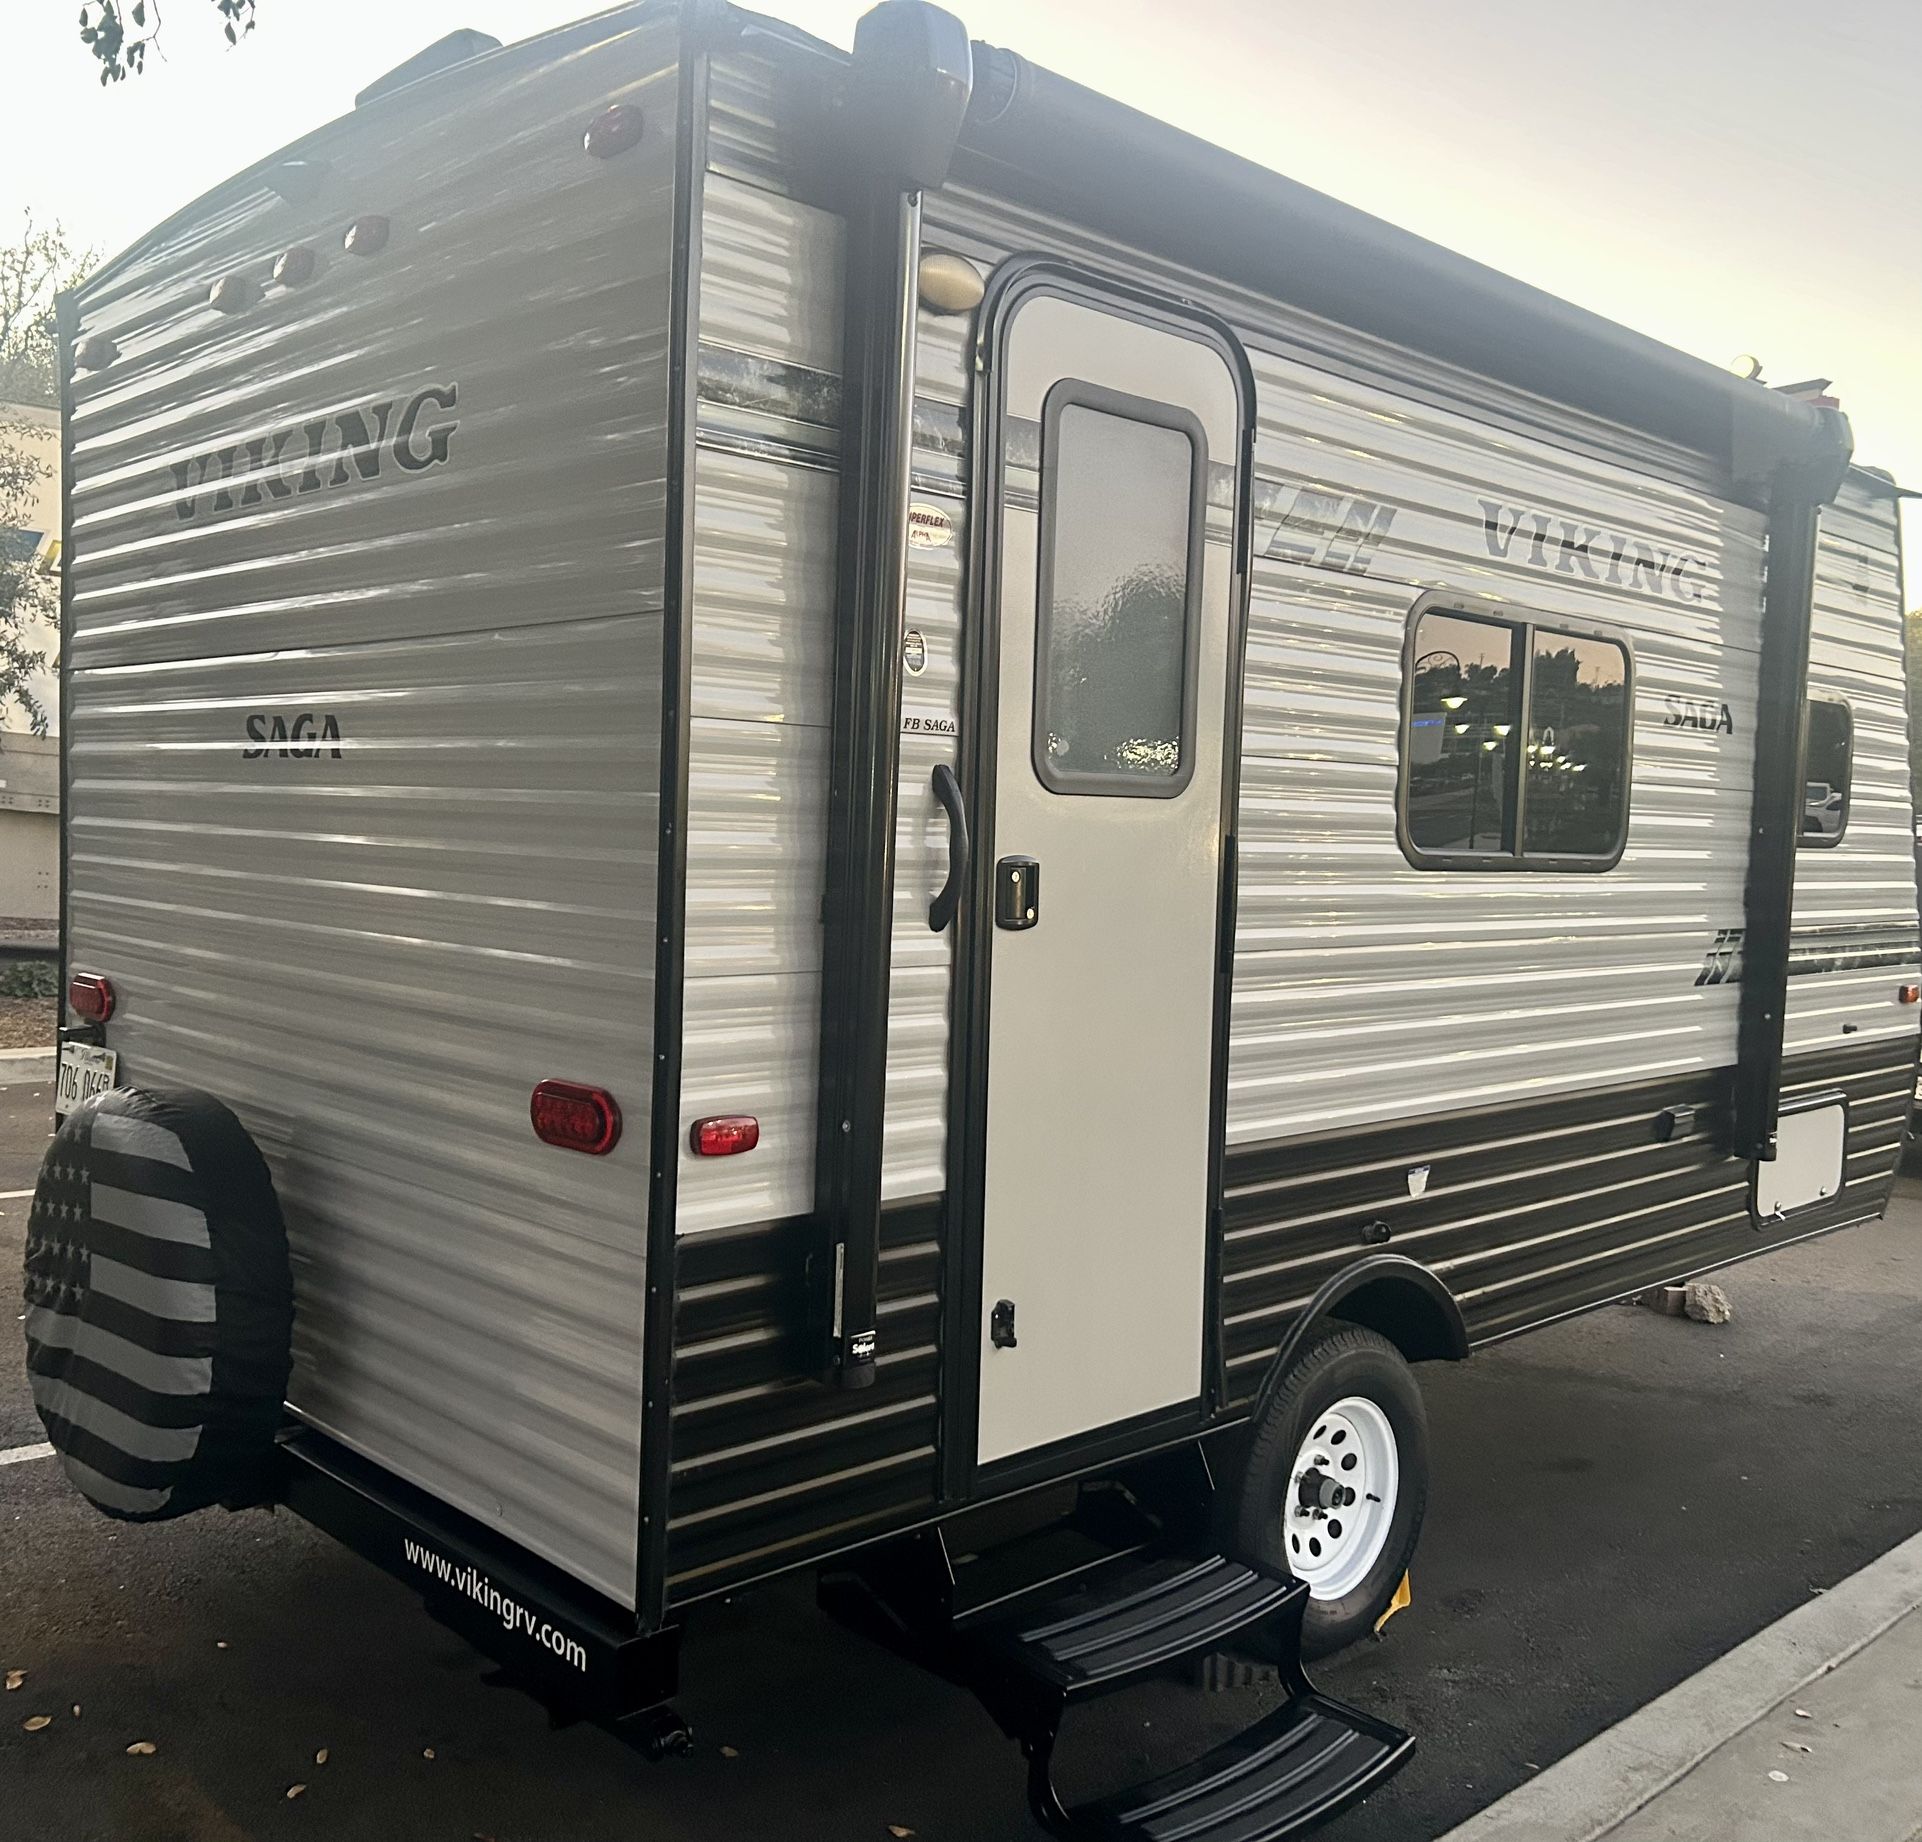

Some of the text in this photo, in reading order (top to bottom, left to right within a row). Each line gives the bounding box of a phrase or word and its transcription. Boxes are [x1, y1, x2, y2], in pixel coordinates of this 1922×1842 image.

[168, 382, 460, 521] VIKING
[1477, 498, 1708, 603] VIKING
[242, 712, 342, 759] SAGA
[903, 717, 956, 733] FB SAGA
[1663, 694, 1733, 735] SAGA
[60, 1063, 79, 1101] 706
[404, 1538, 587, 1672] www.vikingrv.com
